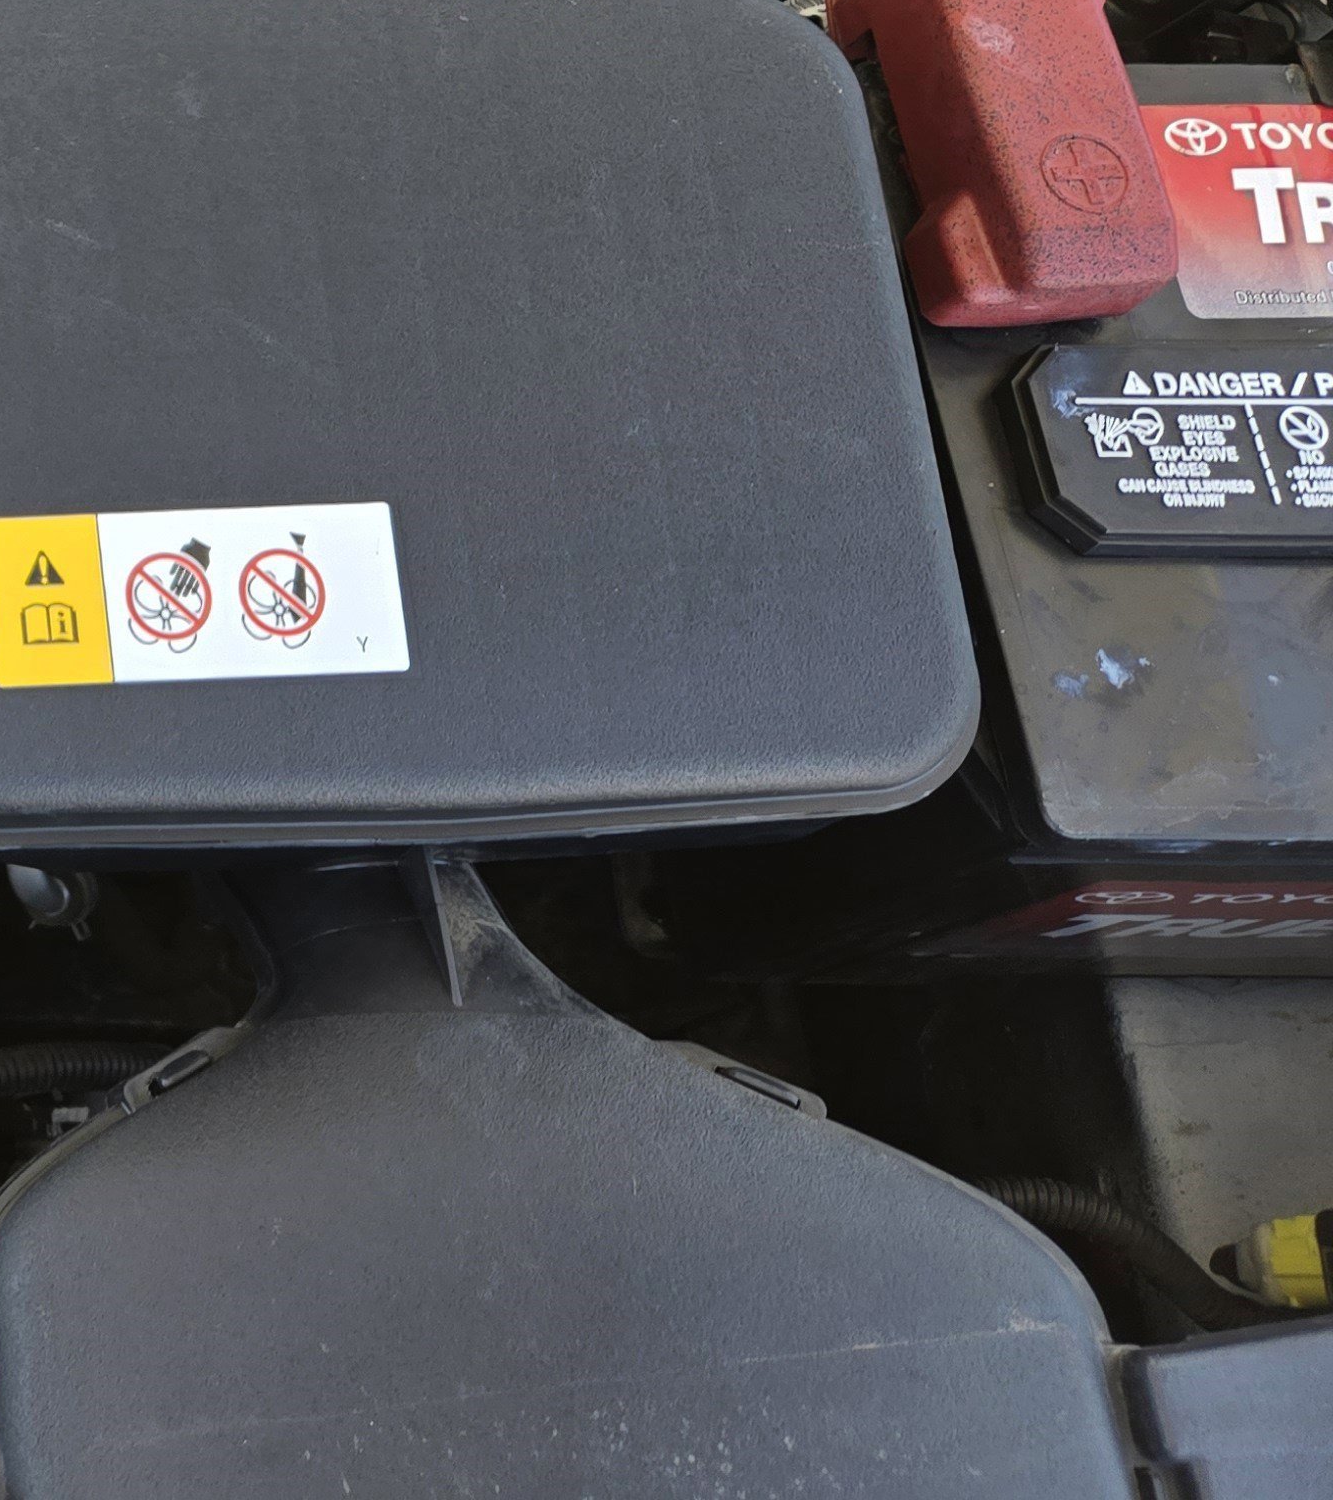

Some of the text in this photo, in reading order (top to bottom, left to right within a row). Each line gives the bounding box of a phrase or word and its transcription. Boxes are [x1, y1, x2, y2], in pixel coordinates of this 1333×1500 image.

[1235, 289, 1326, 305] Distributed
[1153, 371, 1285, 397] DANGER
[1177, 414, 1236, 431] SHIELD
[1182, 430, 1226, 446] EYES
[1149, 445, 1240, 462] EXPLOSIVE
[1298, 450, 1325, 465] NO
[1154, 461, 1211, 477] GASES
[1118, 478, 1146, 493] CAN
[1146, 479, 1187, 493] CAUSE
